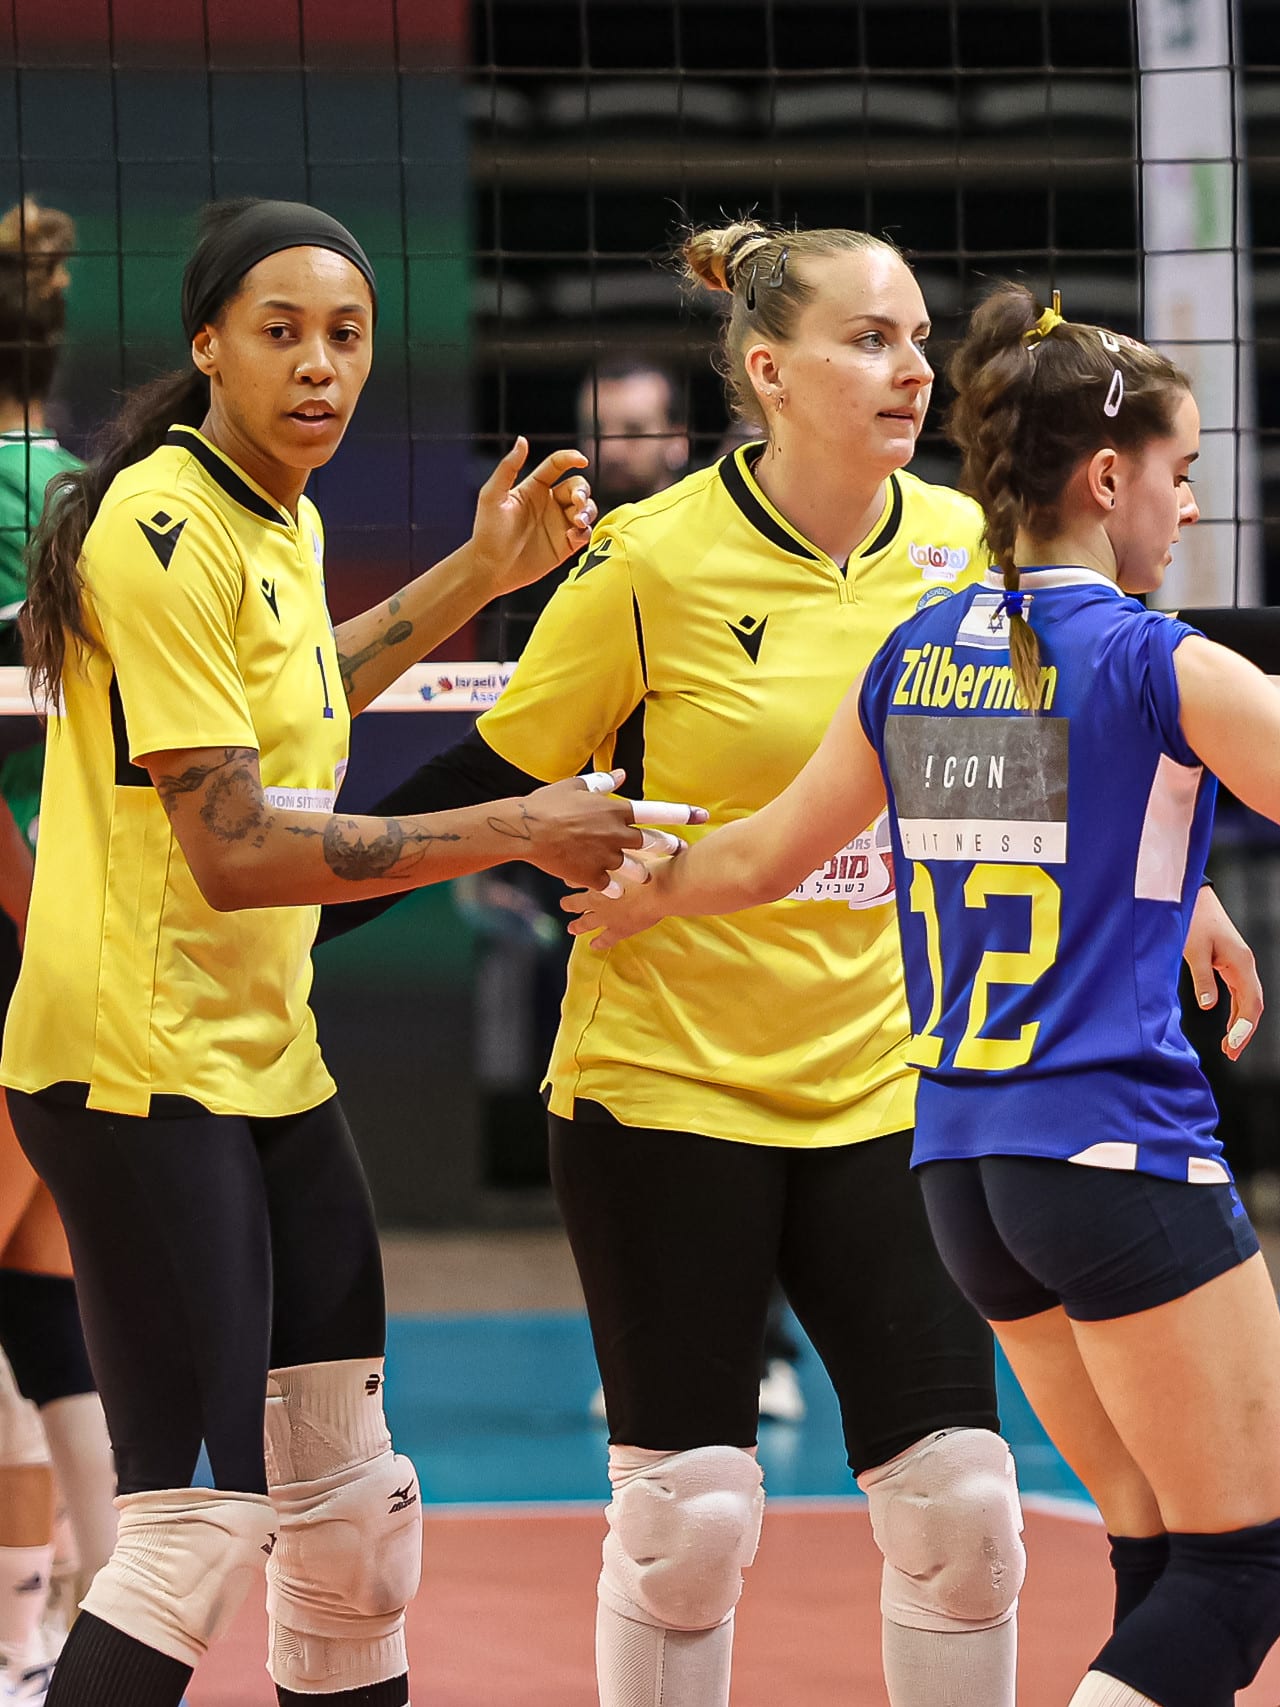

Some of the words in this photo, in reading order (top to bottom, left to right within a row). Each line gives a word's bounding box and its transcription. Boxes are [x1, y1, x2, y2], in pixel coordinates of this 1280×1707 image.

[315, 646, 334, 719] 1
[893, 642, 1057, 710] Zilbermn
[905, 833, 1043, 854] FITNESS
[815, 881, 865, 894] בשביל
[823, 855, 869, 879] מונ
[904, 861, 1061, 1071] 12
